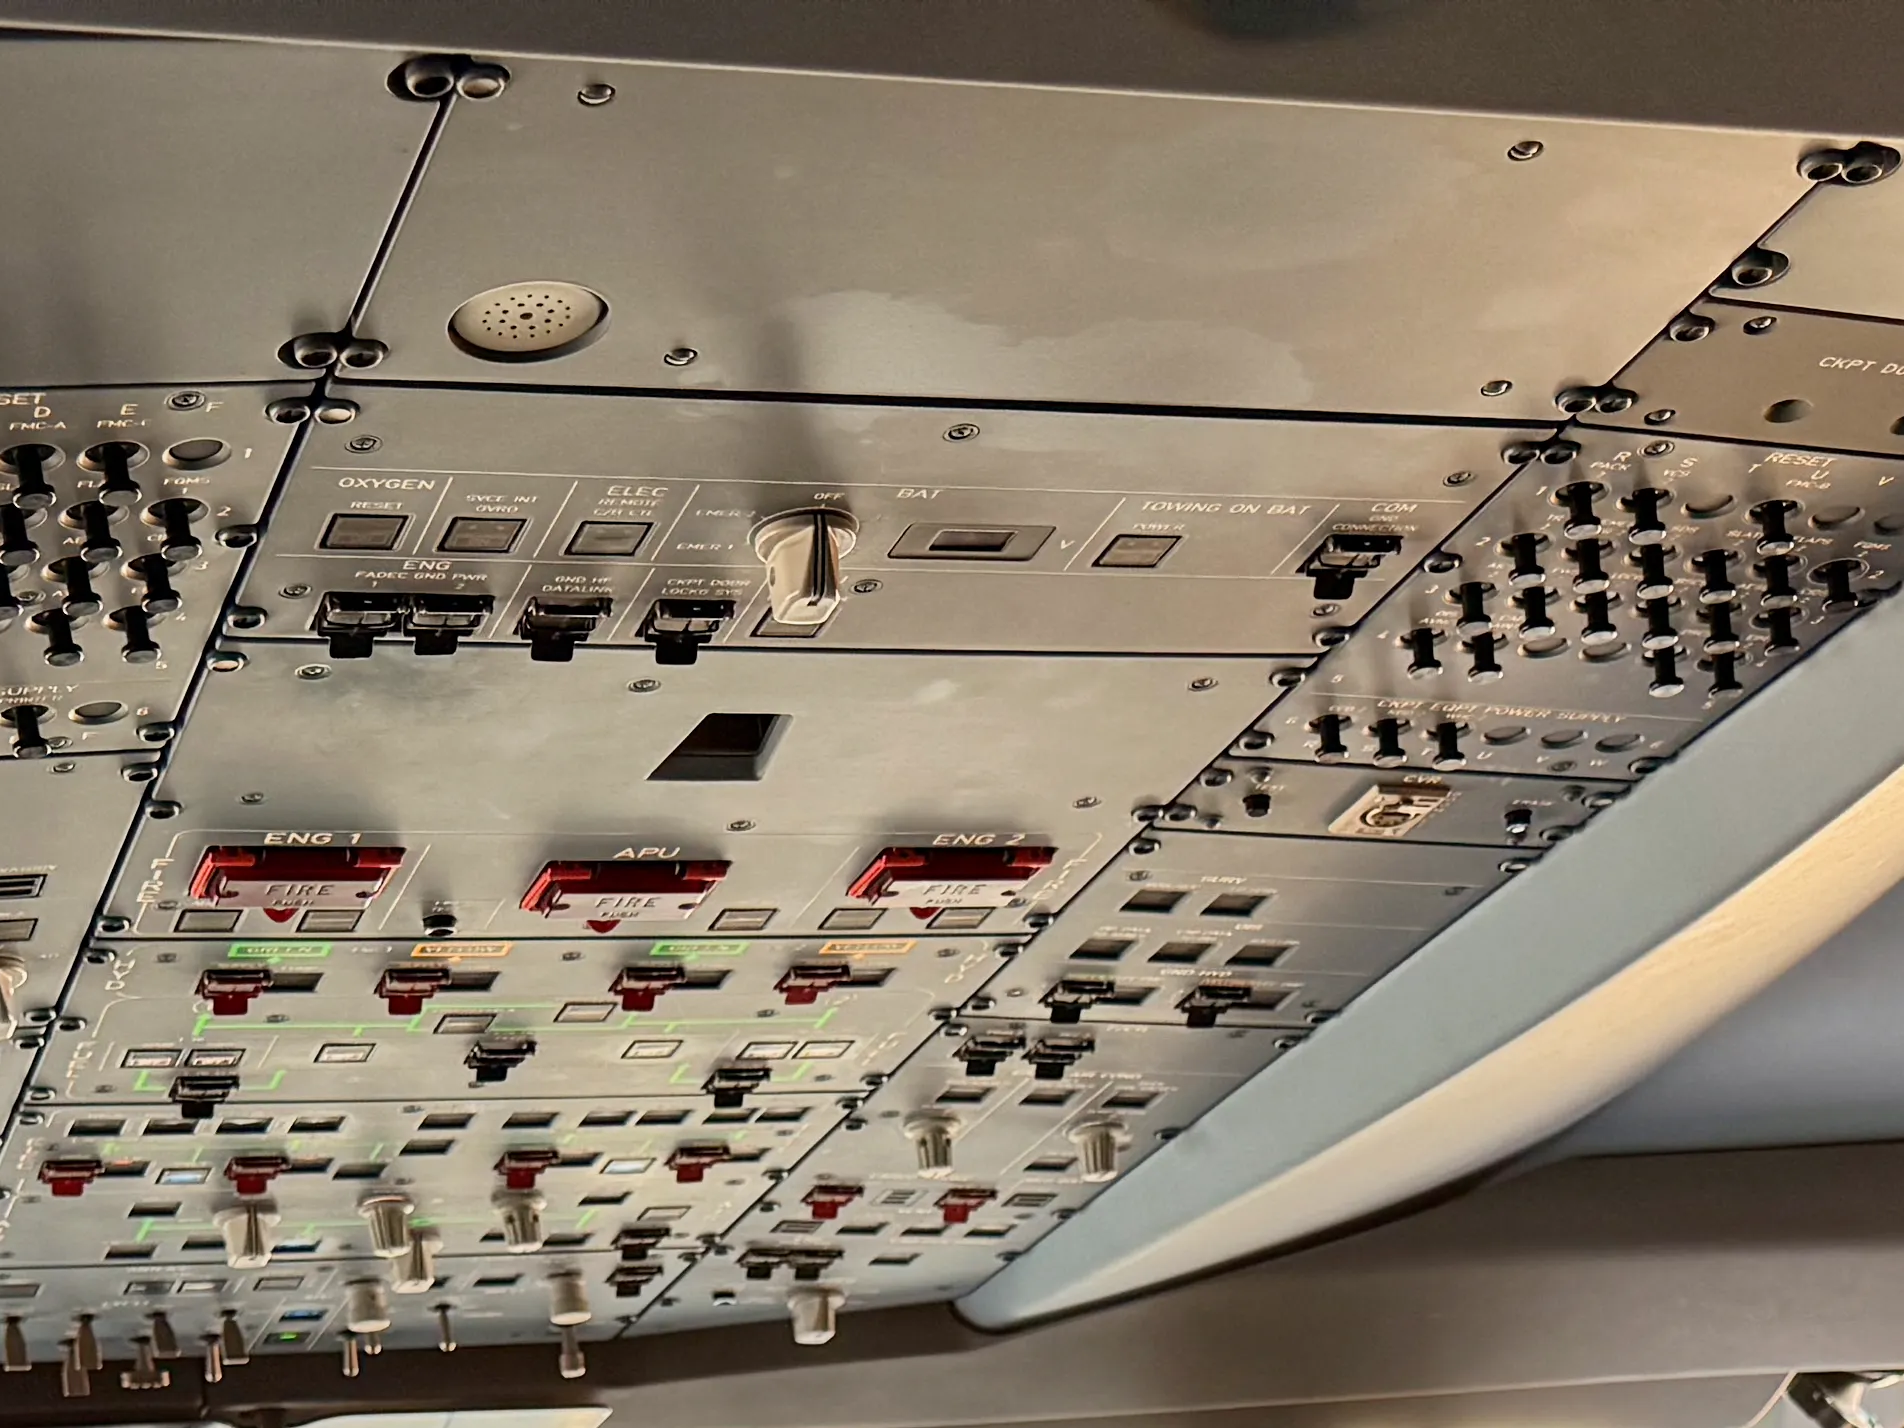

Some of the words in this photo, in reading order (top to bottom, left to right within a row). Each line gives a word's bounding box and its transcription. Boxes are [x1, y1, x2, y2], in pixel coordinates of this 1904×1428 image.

[1818, 356, 1877, 371] CKPT
[33, 406, 52, 419] D
[120, 403, 139, 416] E
[205, 401, 224, 413] F
[9, 421, 67, 431] FMC-A
[1613, 451, 1633, 462] R
[1680, 457, 1699, 468] S
[1763, 451, 1839, 468] RESET
[1589, 461, 1632, 472] PACK
[1748, 463, 1763, 474] T
[1810, 469, 1830, 481] U
[1877, 475, 1895, 487] V
[337, 477, 436, 491] OXYGEN
[606, 485, 669, 498] ELEC
[813, 492, 846, 501] OFF
[896, 487, 945, 500] BAT
[216, 506, 232, 517] 2
[349, 501, 404, 510] RESET
[1140, 500, 1224, 514] TOWING
[1228, 502, 1262, 516] ON
[1266, 503, 1313, 517] BAT
[1370, 502, 1419, 514] COM
[193, 561, 209, 571] 3
[402, 560, 453, 571] ENG
[354, 570, 410, 580] FADEC
[413, 572, 447, 581] GND
[451, 572, 489, 582] PWR
[1867, 569, 1885, 580] 2
[541, 584, 615, 594] DATALINK
[1403, 774, 1443, 785] CVR
[262, 832, 334, 845] ENG
[350, 832, 362, 845] 1
[932, 833, 997, 846] ENG
[1005, 833, 1026, 845] 2
[613, 846, 681, 859] APU
[266, 883, 336, 897] FIRE
[923, 882, 989, 897] FIRE
[594, 896, 662, 909] FIRE
